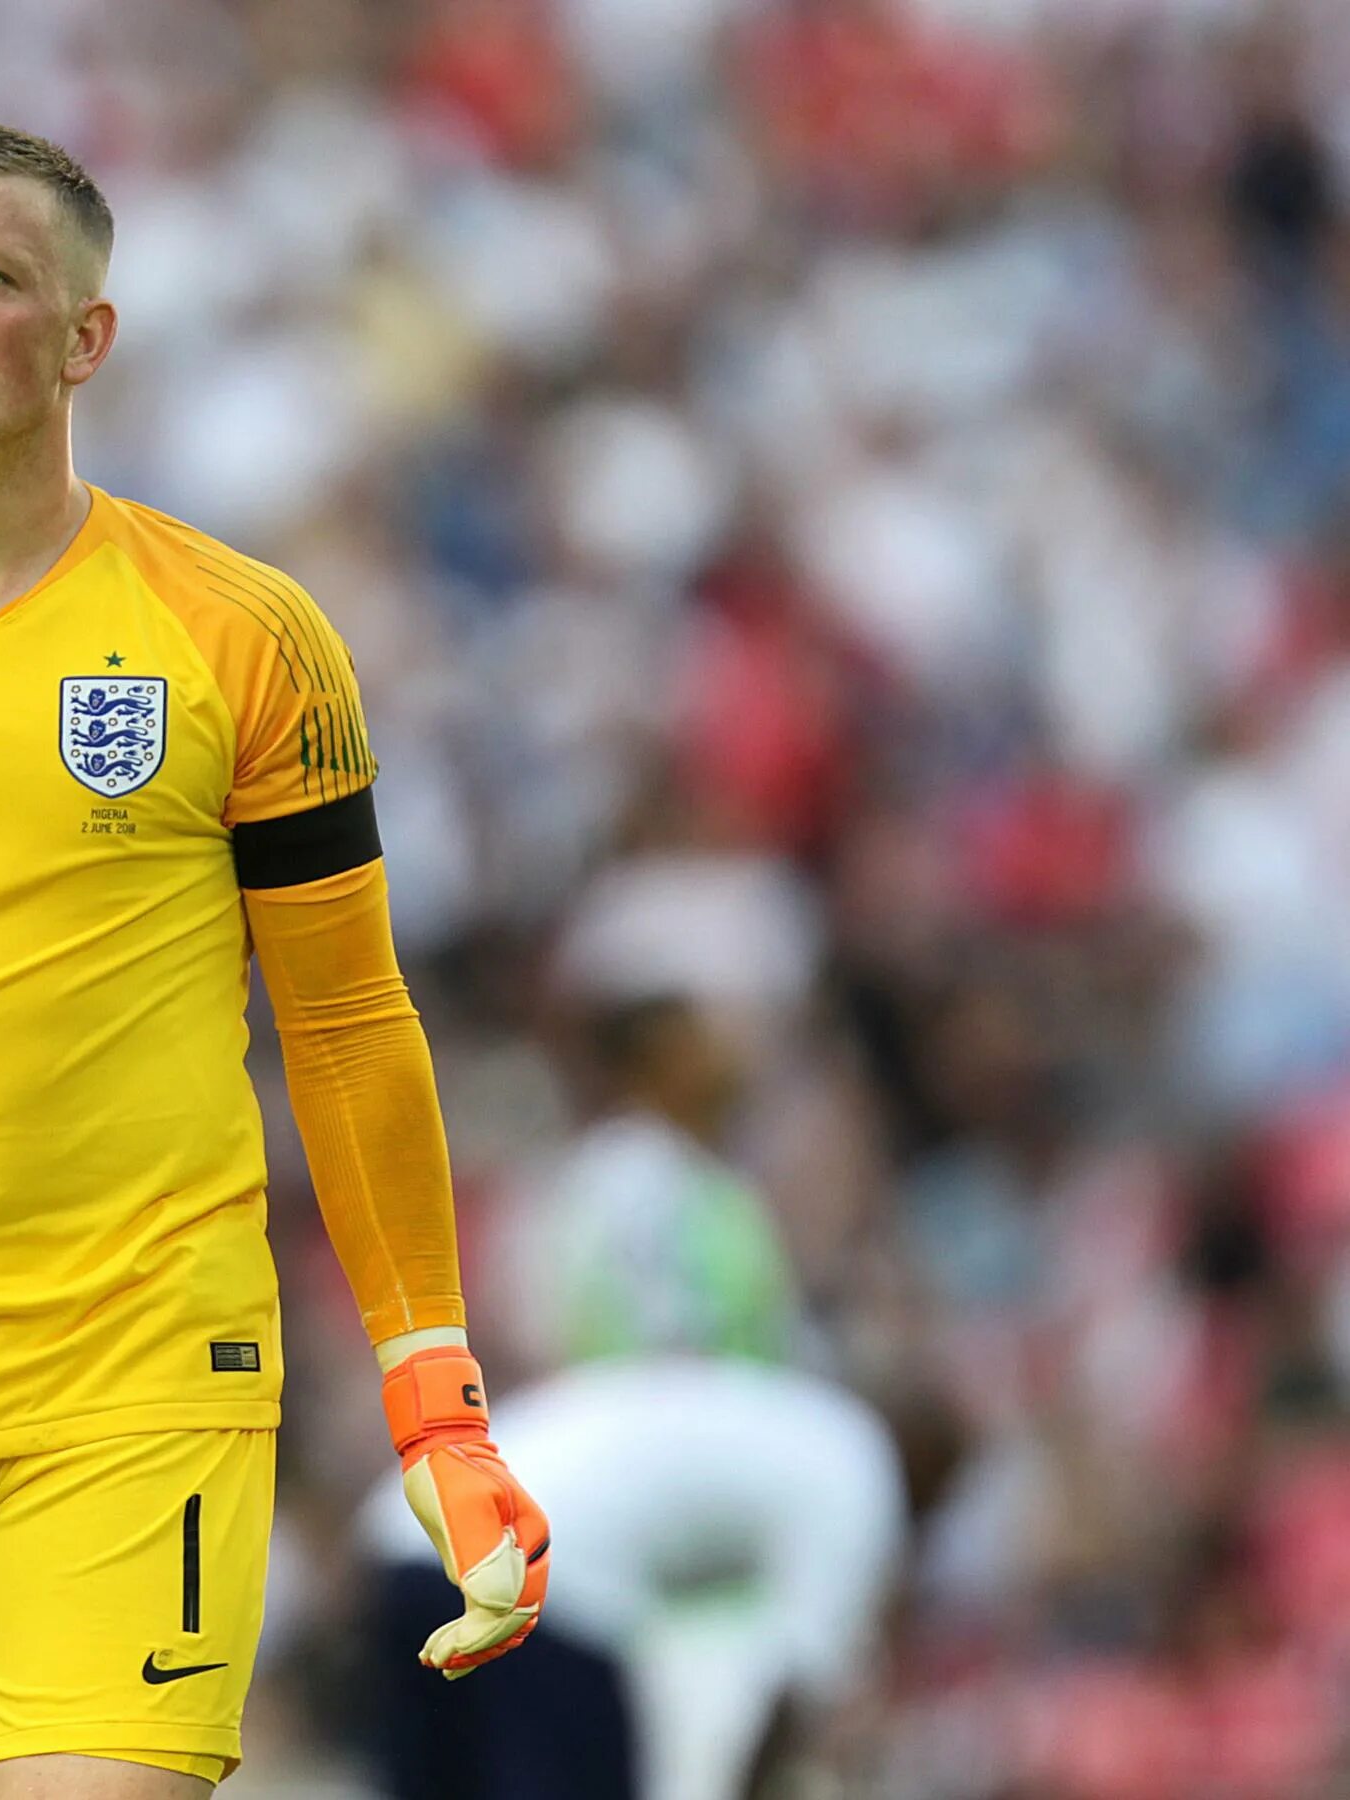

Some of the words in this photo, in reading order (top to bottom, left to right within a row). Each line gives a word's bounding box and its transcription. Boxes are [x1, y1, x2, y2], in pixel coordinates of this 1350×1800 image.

[91, 808, 128, 819] NIGERIA
[81, 822, 88, 833] 2
[91, 822, 112, 833] JUNE
[115, 822, 136, 833] 2018
